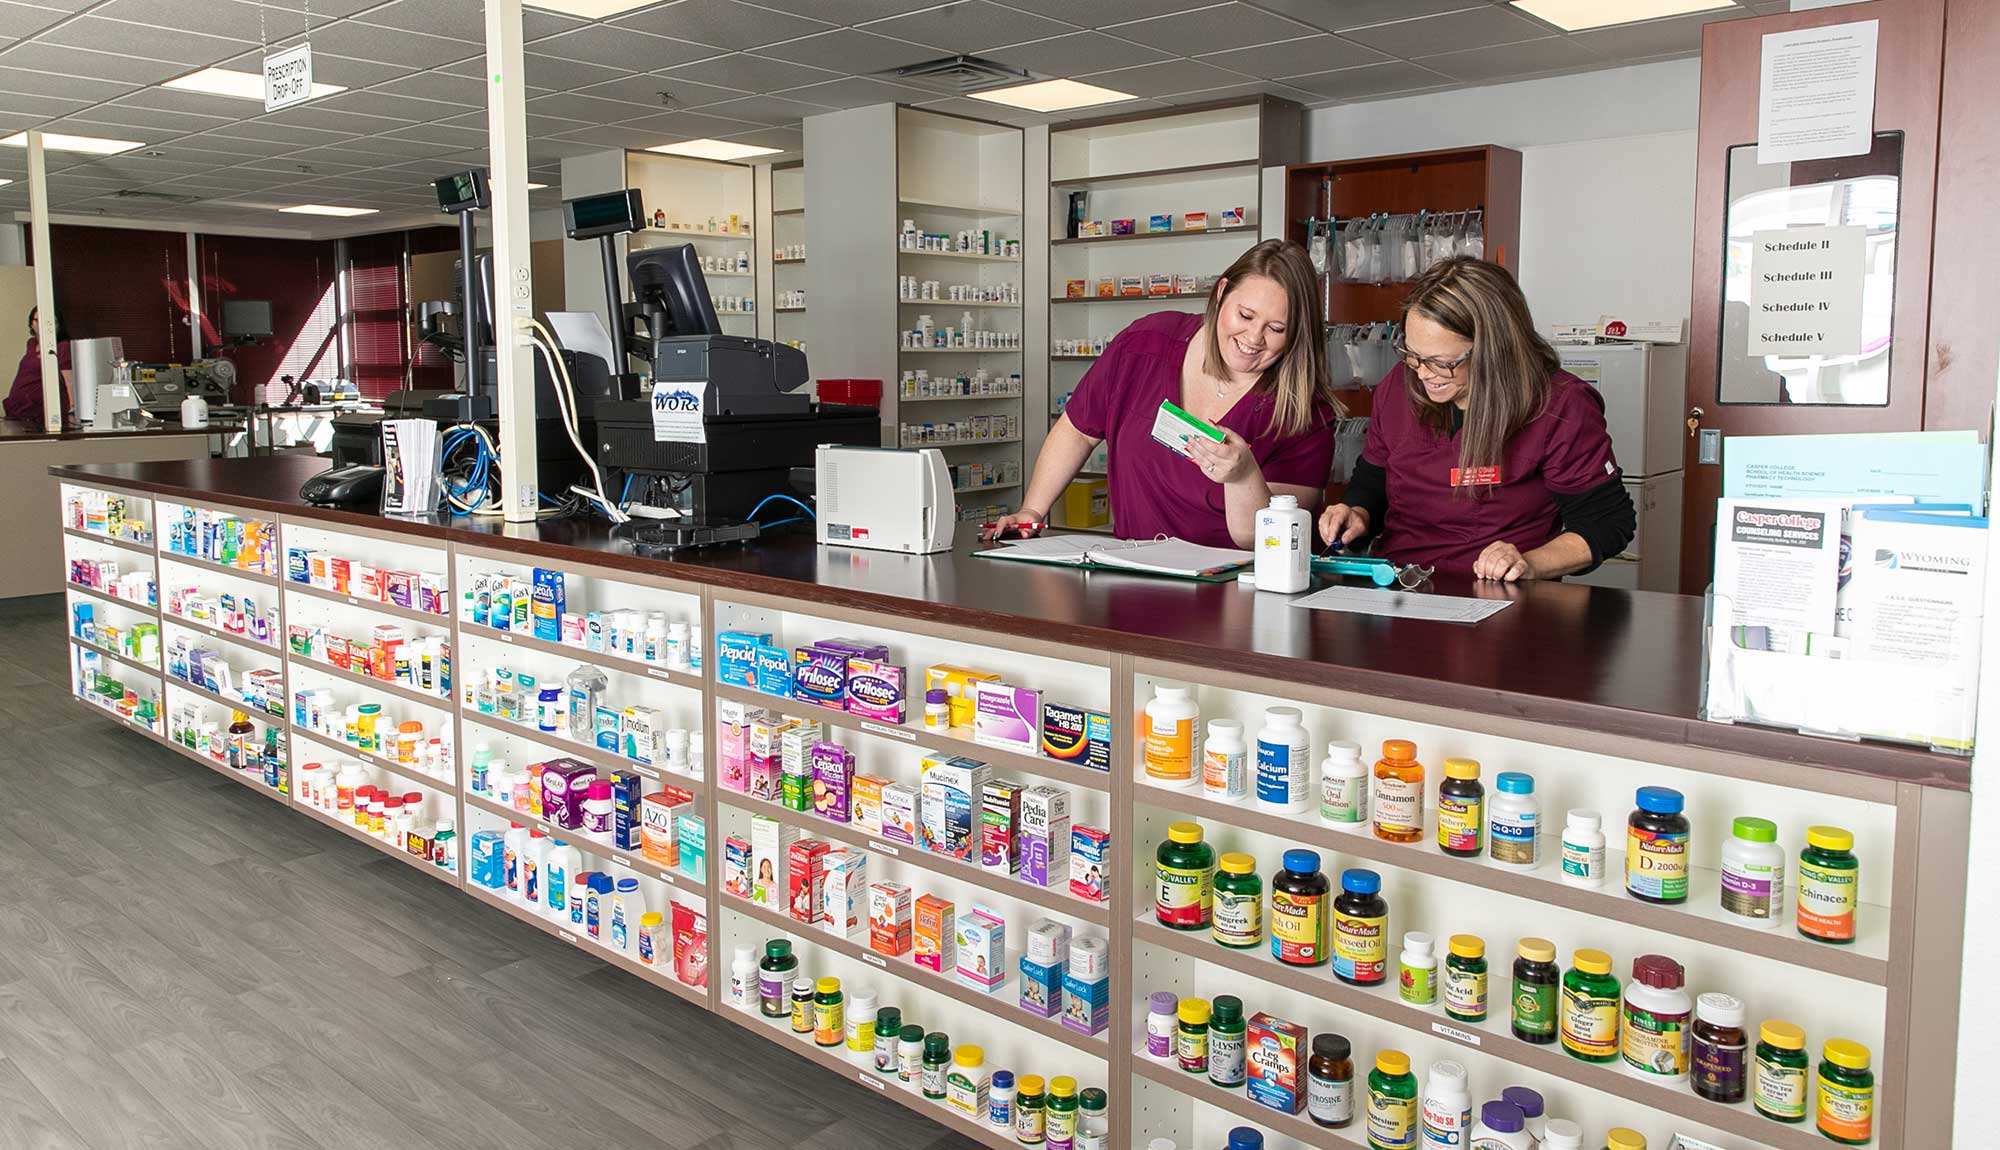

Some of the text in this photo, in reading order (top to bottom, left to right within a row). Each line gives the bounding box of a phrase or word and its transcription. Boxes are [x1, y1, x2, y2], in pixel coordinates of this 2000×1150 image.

[268, 58, 307, 82] PRESCRIPTION
[273, 78, 303, 100] DROP-OFF
[1764, 240, 1830, 252] Schedule II
[1763, 271, 1833, 282] Schedule III
[1762, 301, 1831, 312] Schedule IV
[1760, 332, 1825, 342] Schedule V
[1737, 511, 1821, 531] Casper College
[1736, 526, 1781, 538] COUNSELING
[1783, 530, 1819, 541] SERVICES
[1901, 551, 1971, 567] WYOMING
[720, 644, 756, 663] Pepcid
[759, 655, 787, 672] Pepcid
[797, 667, 841, 689] Prilosec
[852, 680, 896, 700] Prilosec
[1044, 705, 1083, 723] Tagamet
[1059, 720, 1082, 732] HB 200
[813, 756, 843, 773] Cepacol
[929, 771, 960, 786] Mucinex
[1327, 790, 1341, 799] Oral
[1376, 789, 1415, 803] Cinnamon
[1023, 801, 1047, 818] Pedia
[645, 807, 668, 828] AZO
[1024, 812, 1045, 827] Care
[1501, 826, 1522, 836] Q-10
[1658, 862, 1679, 871] 2000
[1170, 874, 1198, 884] VALLEY
[1742, 879, 1757, 890] D-3
[1162, 885, 1170, 902] E
[1800, 885, 1848, 904] Echinacea
[1285, 920, 1301, 932] Oil
[1367, 938, 1380, 949] Oil
[1455, 987, 1473, 995] Acid
[1571, 1016, 1594, 1027] Ginger
[1440, 1026, 1472, 1041] VITAMINS
[1263, 1047, 1279, 1061] Leg
[1252, 1051, 1290, 1074] Cramps
[1265, 1071, 1277, 1081] PM
[1780, 1084, 1793, 1093] Tea
[1825, 1095, 1868, 1111] Green Tea
[1445, 1116, 1454, 1126] SR
